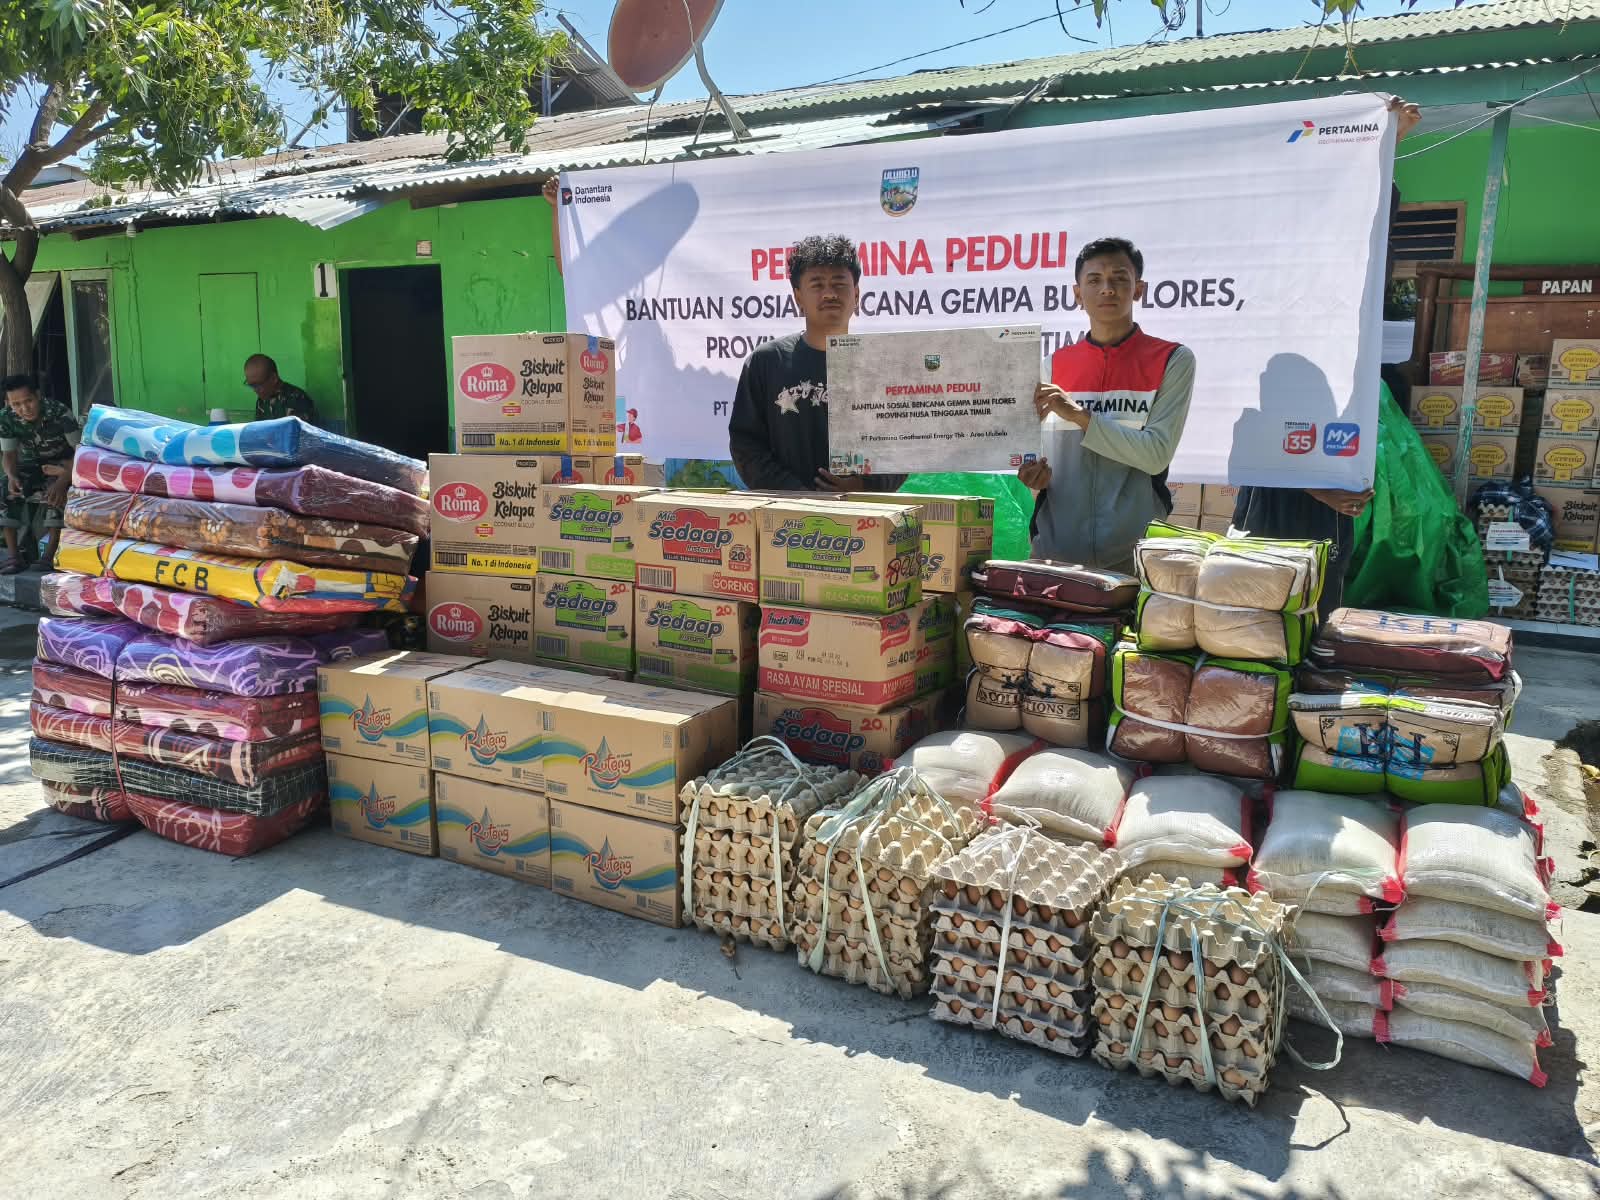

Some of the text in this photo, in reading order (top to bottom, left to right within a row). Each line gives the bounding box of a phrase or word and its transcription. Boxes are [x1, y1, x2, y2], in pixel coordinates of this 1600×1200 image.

[1319, 123, 1379, 135] PERTAMINA
[575, 184, 612, 195] Danantara
[575, 194, 611, 204] Indonesia
[752, 231, 1067, 281] PEINA PEDULI
[318, 263, 328, 297] 1
[1542, 280, 1592, 293] PAPAN
[626, 297, 723, 320] BANTUAN
[731, 294, 806, 319] SOSIA
[941, 285, 1033, 314] GEMPA
[1141, 278, 1244, 311] LORES,
[520, 360, 565, 377] Biskuit
[467, 376, 507, 392] Roma
[521, 376, 563, 398] Kelapa
[886, 382, 981, 395] PERTAMINA PEDULI
[714, 401, 728, 416] PT
[851, 402, 885, 410] BANTUAN
[912, 400, 945, 409] BENCANA
[992, 397, 1016, 405] FLORES
[909, 410, 929, 418] NUSA
[931, 409, 968, 417] TENGGARA
[500, 438, 512, 446] No.
[518, 438, 525, 446] di
[526, 438, 560, 446] Indonesia
[493, 481, 538, 499] Biskuit
[441, 495, 480, 512] Roma
[493, 501, 535, 521] Kelapa
[549, 503, 623, 528] Sedaap
[648, 520, 733, 549] Sedaap
[771, 528, 865, 557] Sedaap
[471, 558, 483, 566] No.
[490, 560, 497, 568] di
[498, 560, 532, 570] Indonesia
[731, 551, 745, 561] 20
[712, 579, 754, 592] GORENG
[543, 592, 617, 616] Sedaap
[437, 614, 475, 632] Roma
[488, 605, 532, 623] Biskuit
[489, 623, 529, 644] Kelapa
[645, 611, 724, 639] Sedaap
[766, 671, 791, 686] RASA
[792, 675, 820, 690] AYAM
[822, 679, 865, 696] SPESIAL
[348, 707, 392, 730] Ruteng
[860, 718, 882, 731] 20
[460, 729, 507, 752] Ruteng
[774, 719, 866, 753] Sedaap
[579, 752, 631, 776] Ruteng
[583, 851, 632, 875] Ruteng
